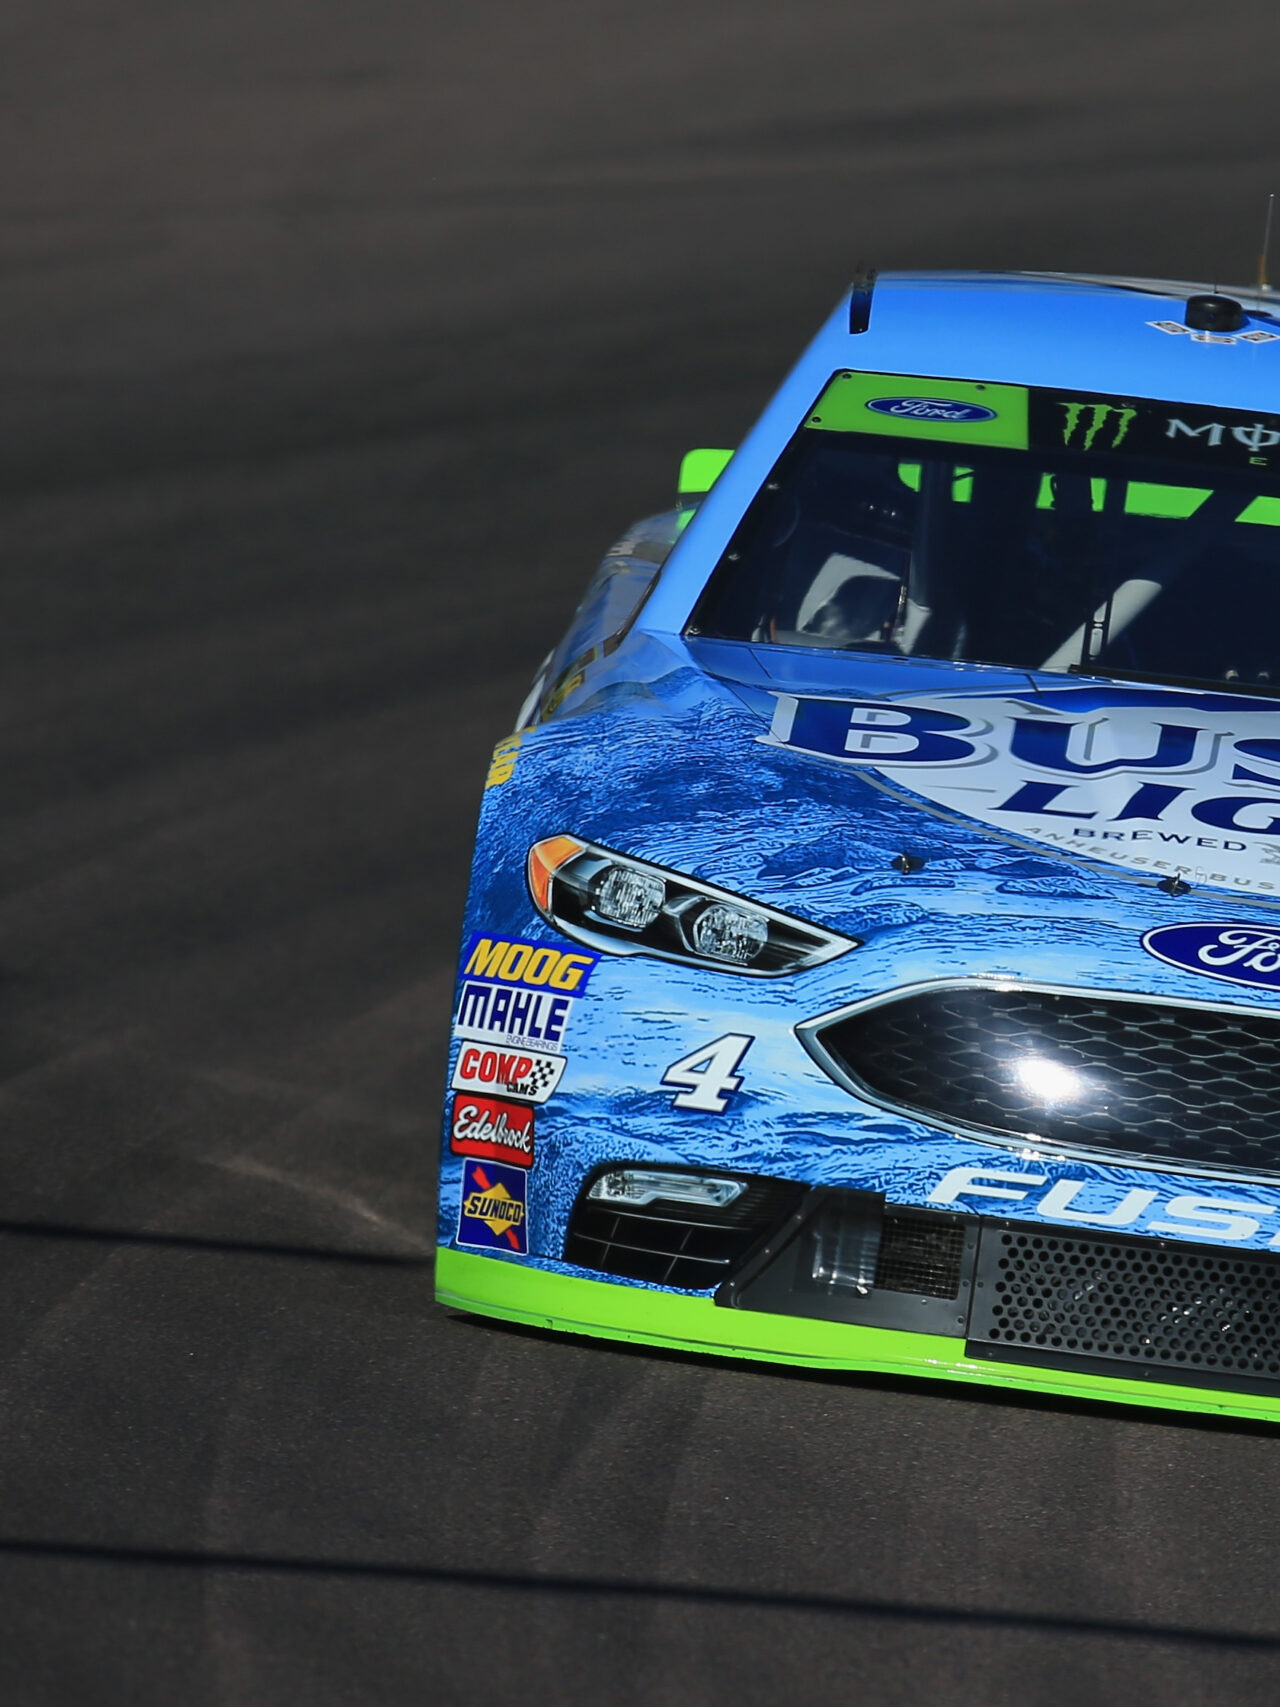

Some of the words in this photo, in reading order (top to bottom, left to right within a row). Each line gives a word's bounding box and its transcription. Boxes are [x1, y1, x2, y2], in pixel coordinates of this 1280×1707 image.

[889, 399, 970, 420] Ford
[1073, 827, 1247, 852] BREWED
[464, 938, 594, 991] MOOG
[457, 984, 570, 1043] MAHLE
[460, 1047, 534, 1085] COMP
[660, 1032, 756, 1117] 4
[453, 1105, 532, 1153] Edelbrock
[467, 1195, 523, 1223] SUNOCO
